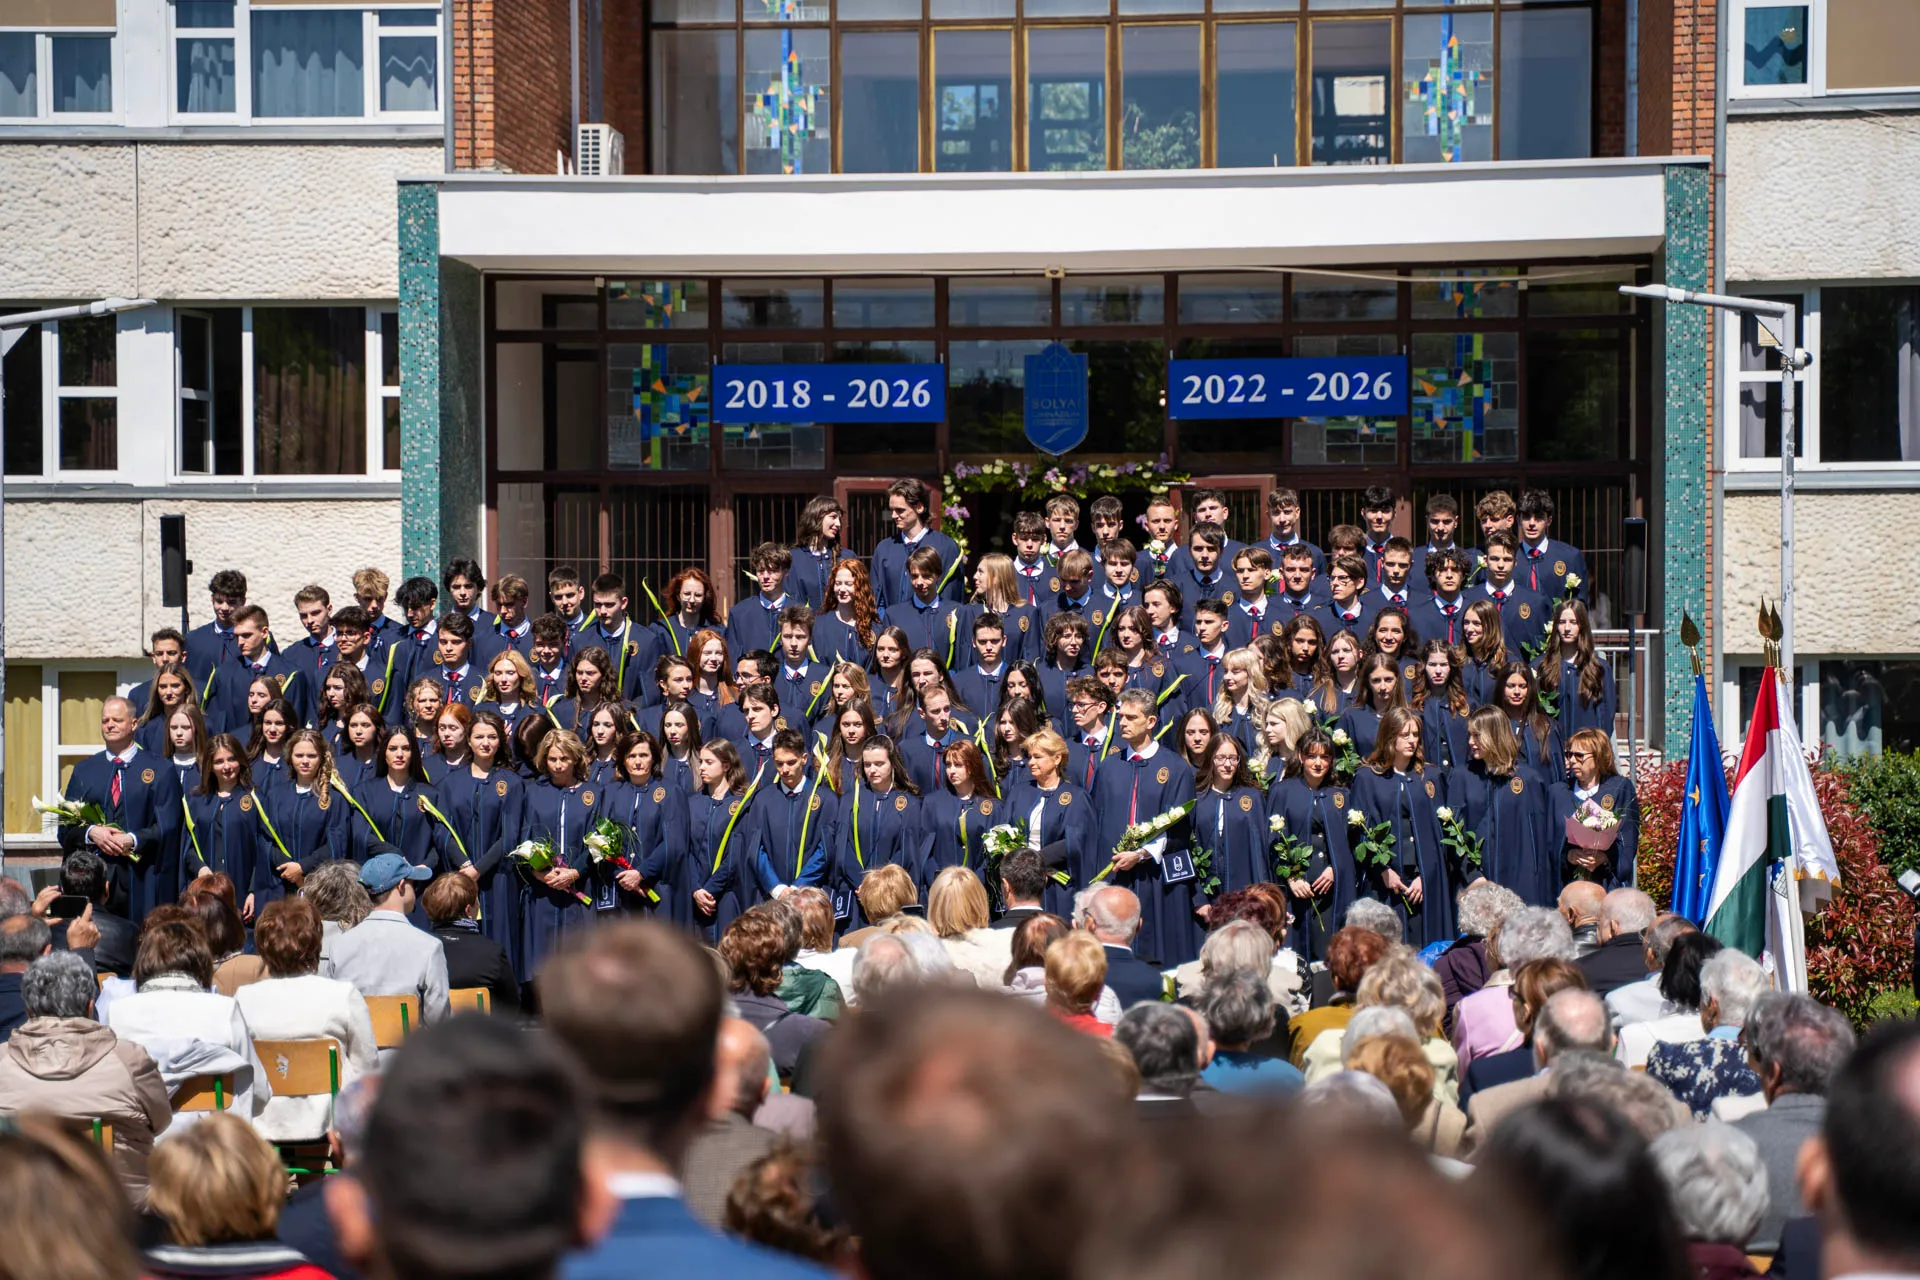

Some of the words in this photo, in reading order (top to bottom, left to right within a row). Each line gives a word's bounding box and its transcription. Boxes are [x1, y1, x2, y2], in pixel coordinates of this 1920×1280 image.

[725, 379, 811, 408] 2018
[847, 379, 931, 408] 2026
[1182, 374, 1267, 404] 2022
[1306, 371, 1392, 401] 2026
